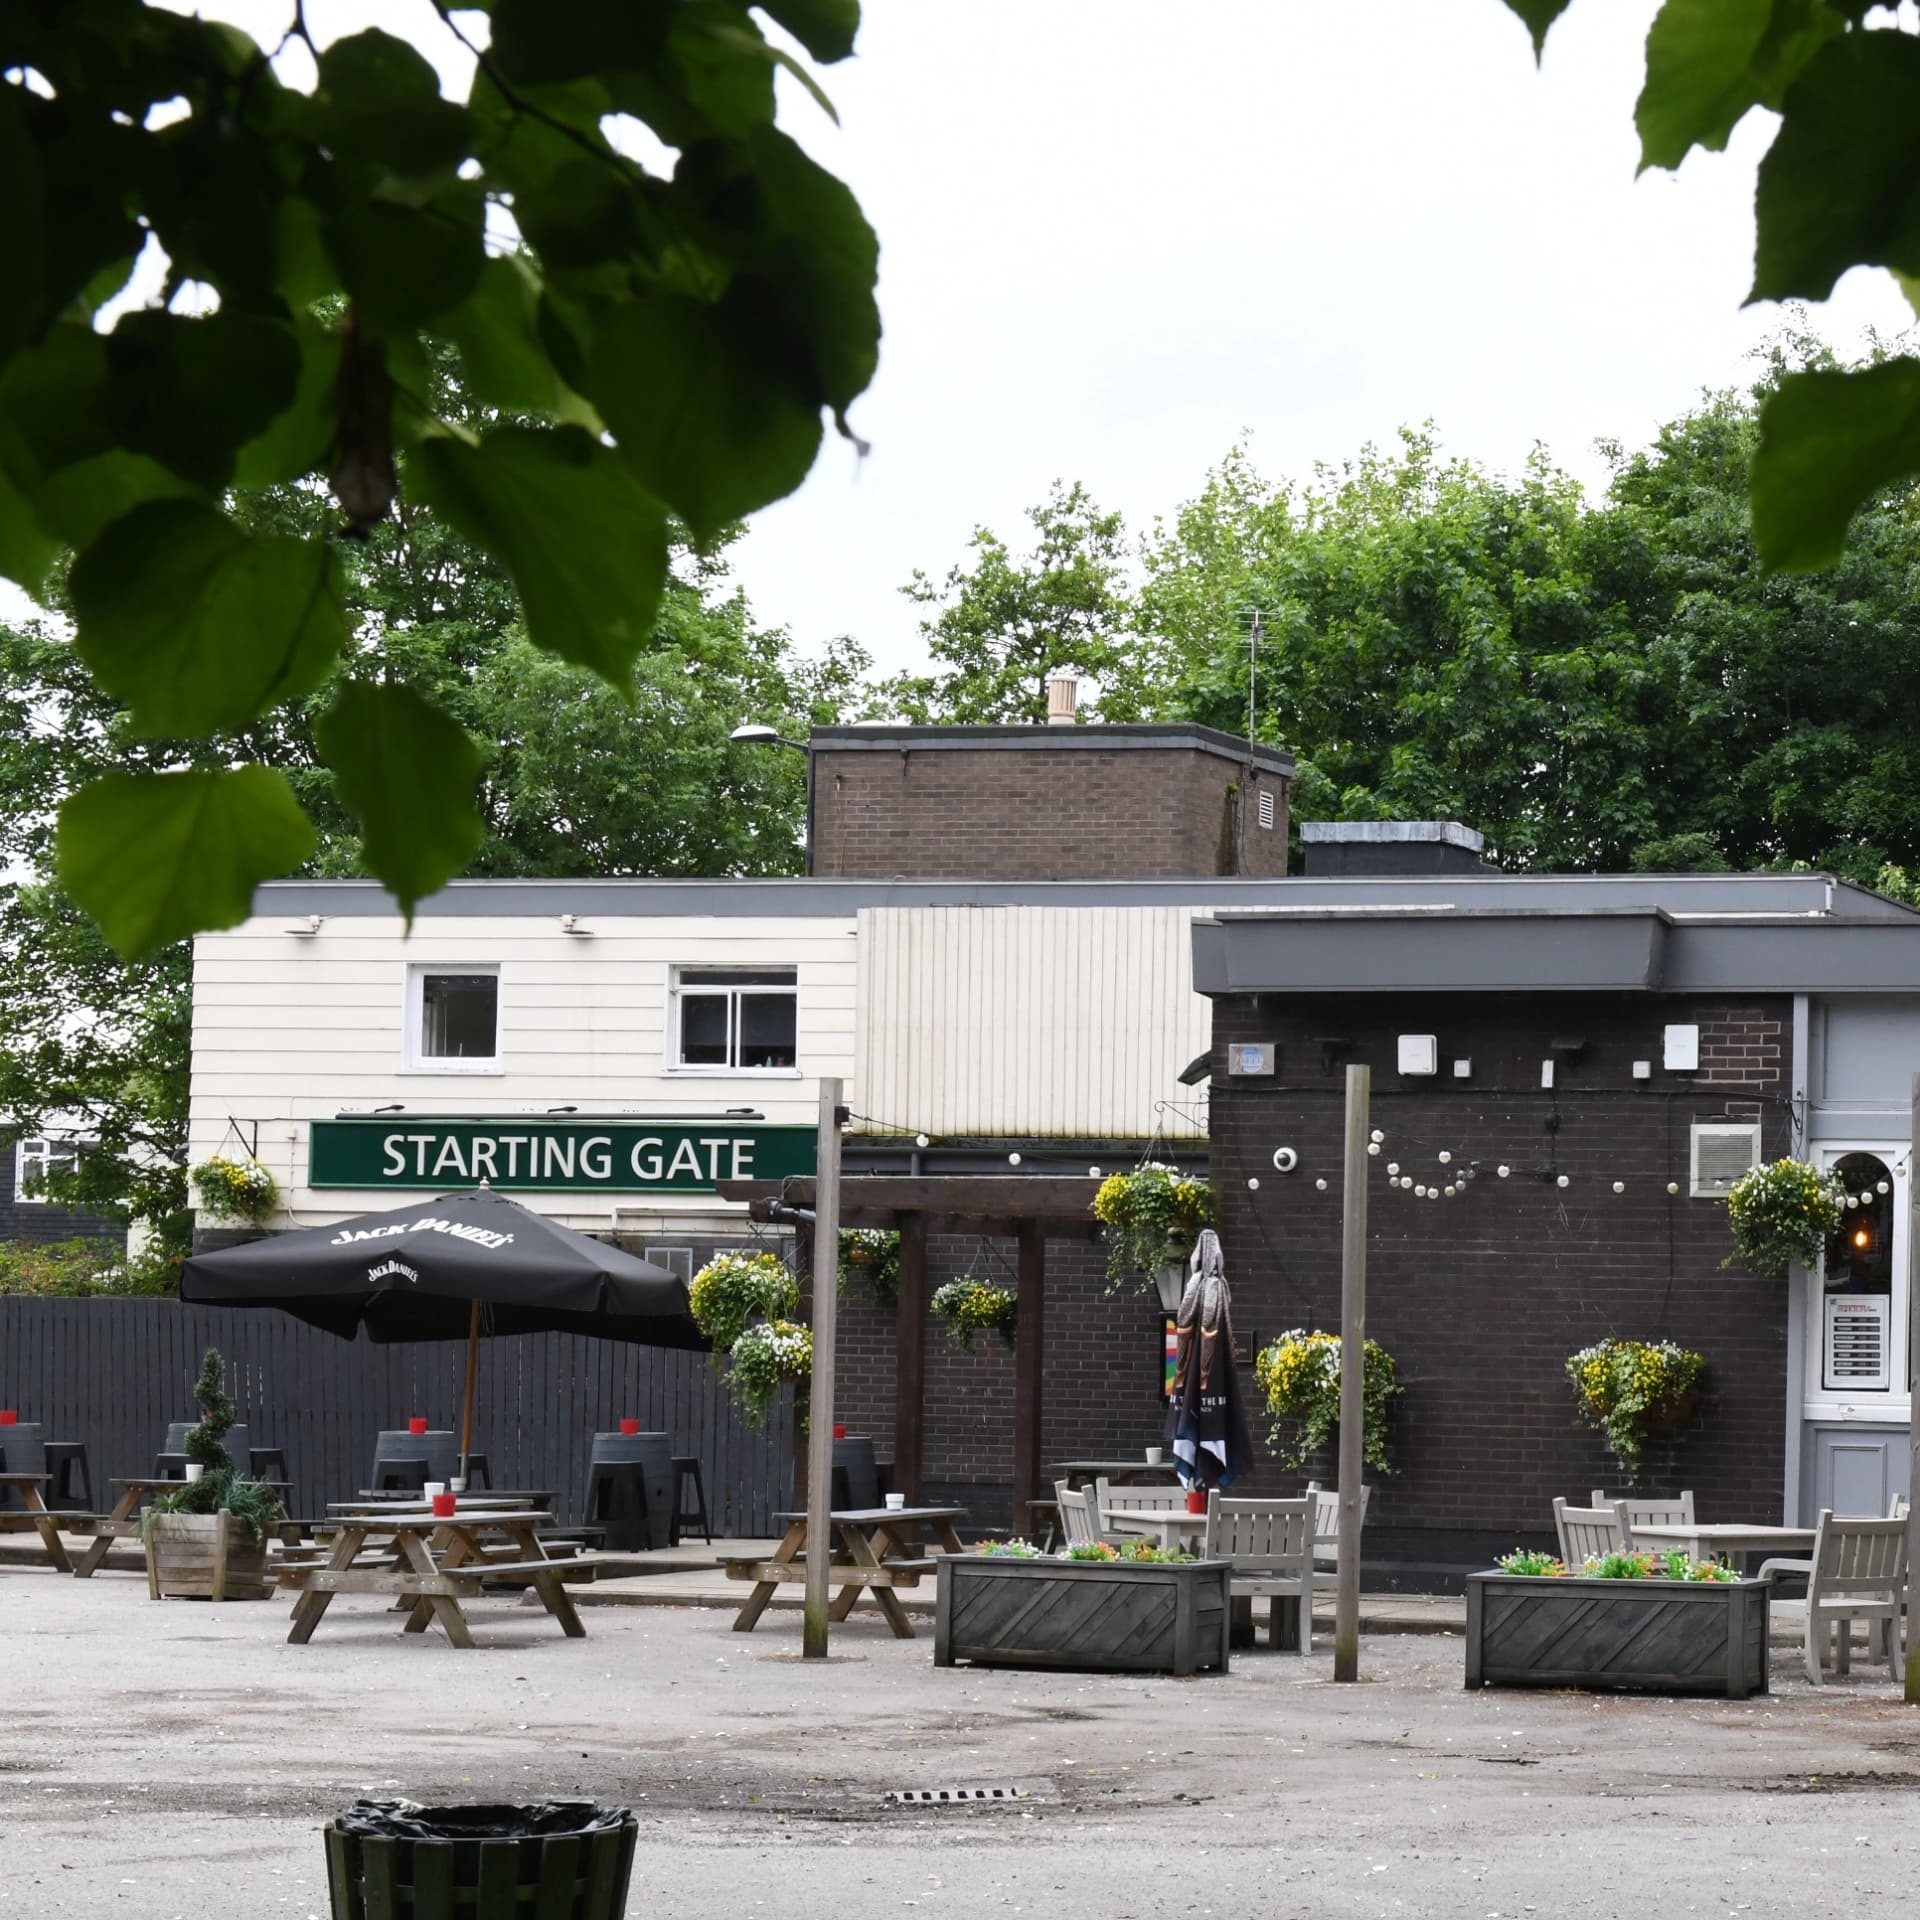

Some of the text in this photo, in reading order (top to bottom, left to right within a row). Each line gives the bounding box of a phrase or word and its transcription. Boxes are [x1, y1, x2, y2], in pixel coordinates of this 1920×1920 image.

[382, 1134, 756, 1181] STARTING GATE
[330, 1217, 515, 1249] JACK DANIEL'S
[368, 1259, 418, 1283] JACK DANIEL'S
